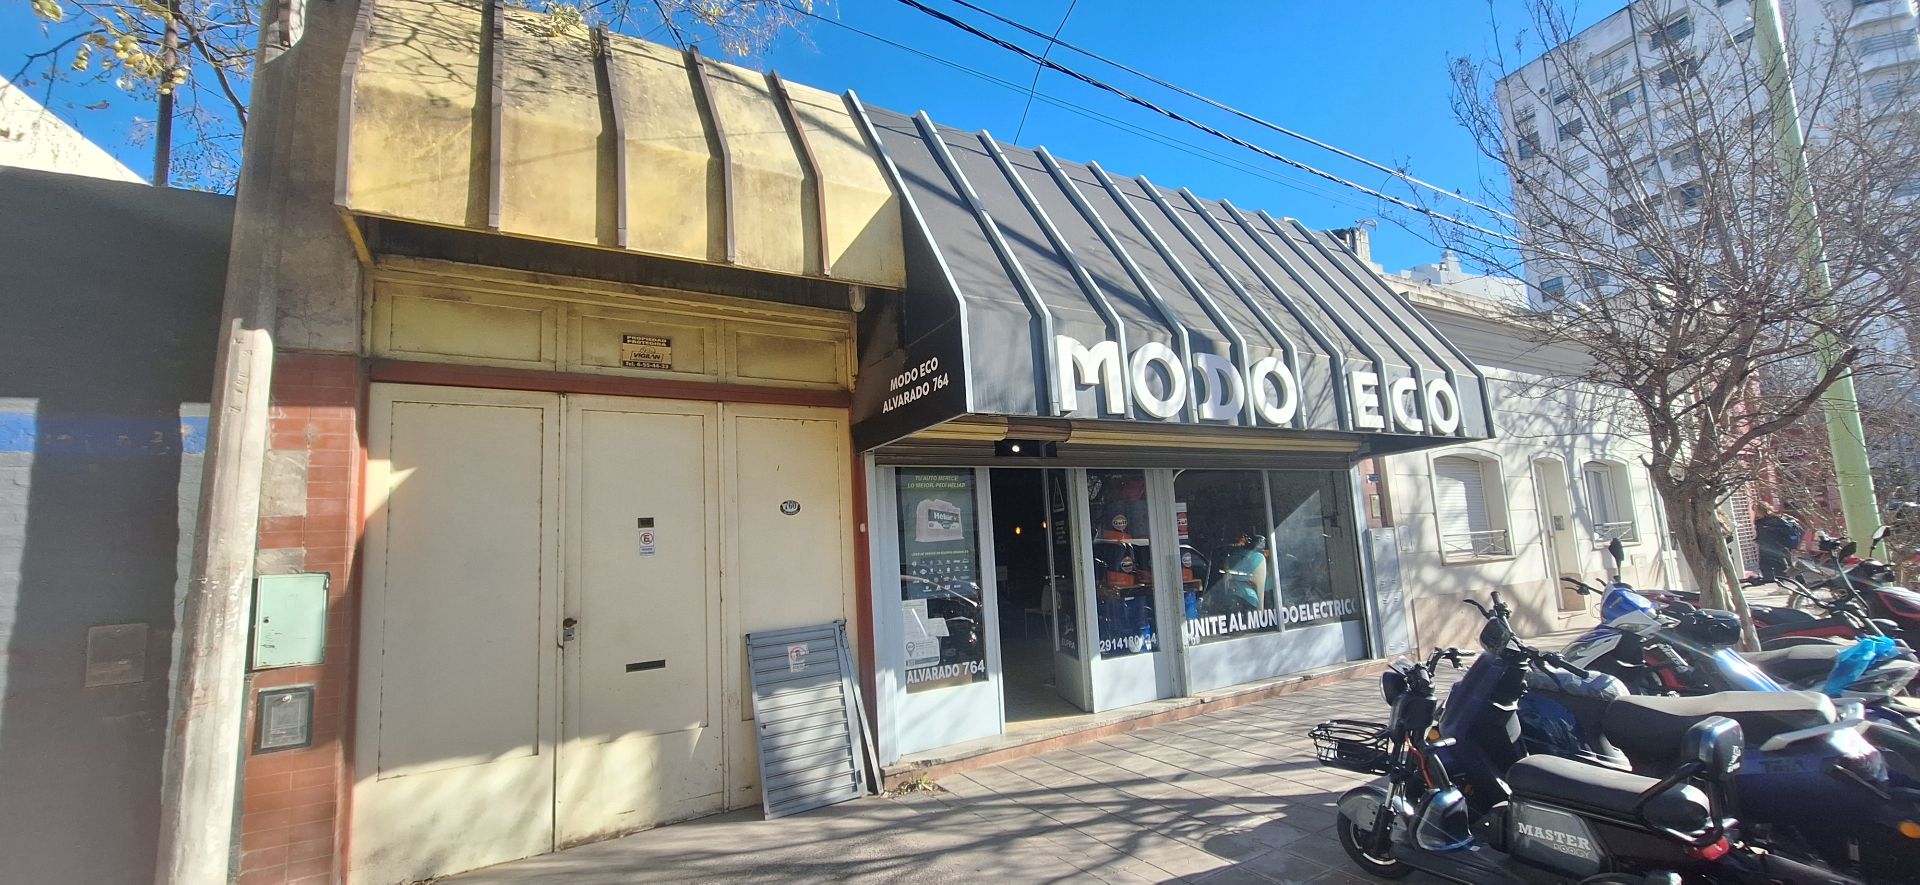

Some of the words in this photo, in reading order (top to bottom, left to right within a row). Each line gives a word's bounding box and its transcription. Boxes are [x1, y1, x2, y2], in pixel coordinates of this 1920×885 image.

[633, 352, 660, 360] VIGILAN
[890, 367, 918, 391] MODO
[920, 357, 939, 377] ECO
[1057, 335, 1297, 424] MODO
[1348, 371, 1459, 434] ECO
[882, 382, 930, 413] ALVARADO
[932, 372, 949, 391] 764
[1184, 614, 1227, 637] UNITE
[1229, 612, 1247, 632] AL
[906, 663, 960, 684] ALVARADO
[962, 659, 985, 675] 764
[1517, 822, 1592, 850] MASTER
